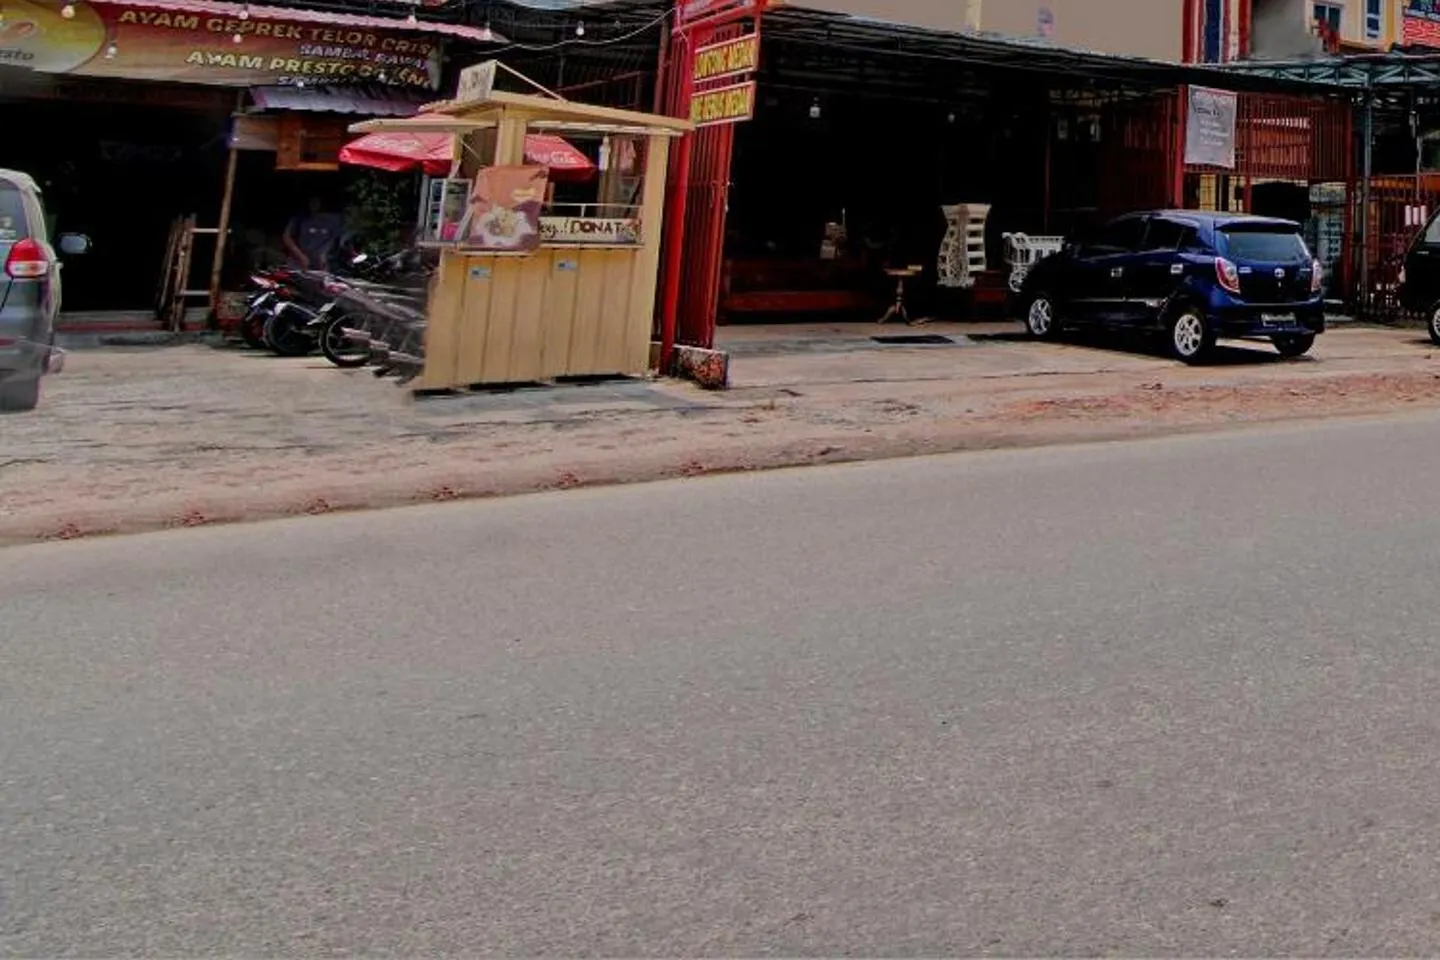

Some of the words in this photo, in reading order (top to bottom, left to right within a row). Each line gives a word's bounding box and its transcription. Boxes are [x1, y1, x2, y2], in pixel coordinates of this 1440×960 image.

[119, 10, 198, 31] AYAM
[206, 16, 302, 41] GEPREK
[310, 27, 378, 47] TELOR
[185, 50, 264, 71] AYAM
